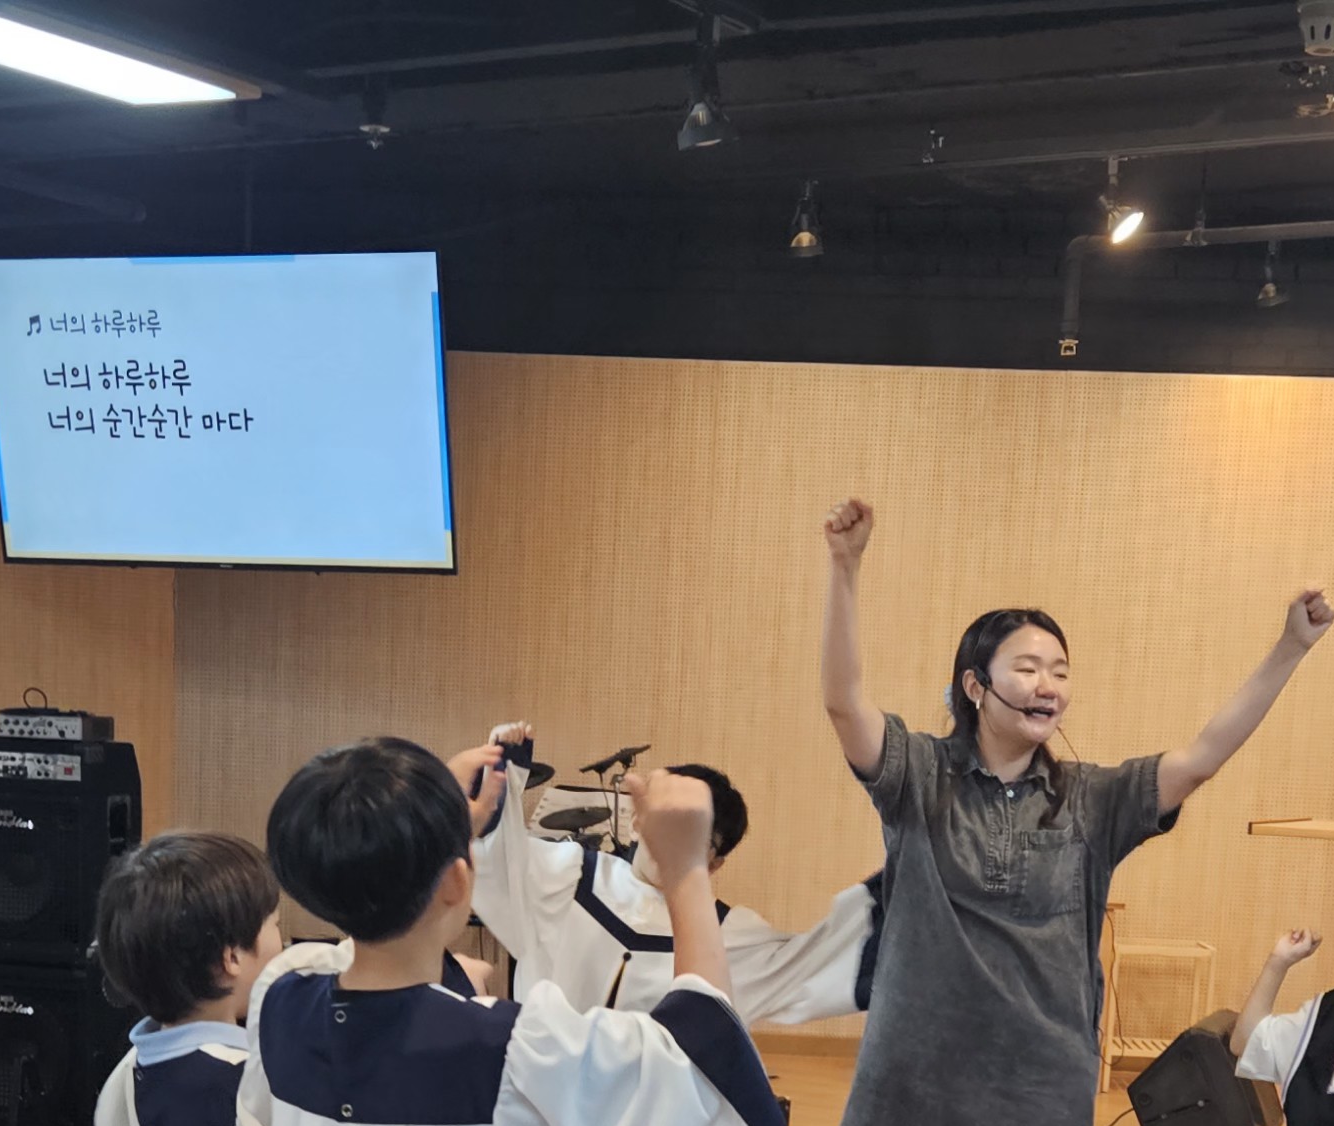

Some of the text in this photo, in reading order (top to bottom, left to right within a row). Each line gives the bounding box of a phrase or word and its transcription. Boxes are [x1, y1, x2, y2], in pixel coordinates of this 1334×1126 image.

[49, 309, 162, 338] 너의 하루하루
[43, 359, 192, 395] 너의 하루하루
[47, 403, 254, 439] 너의 순간순간 마다
